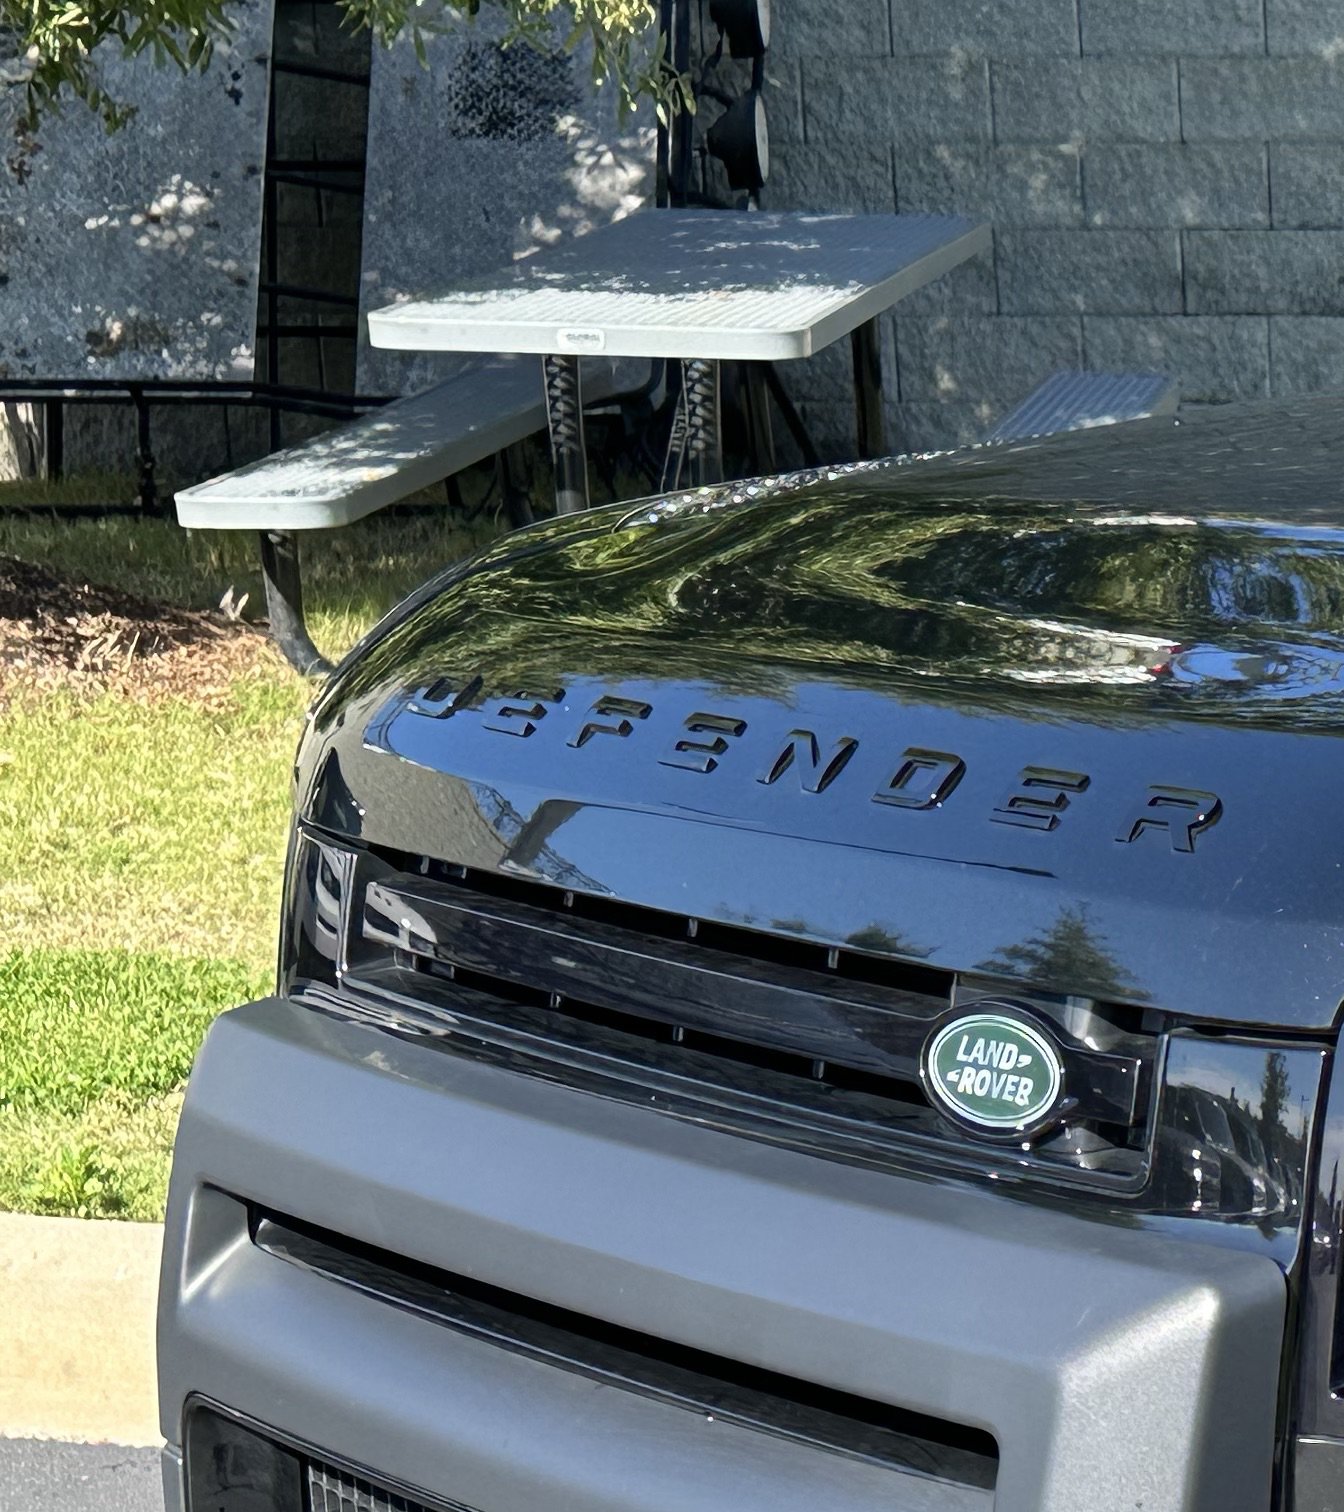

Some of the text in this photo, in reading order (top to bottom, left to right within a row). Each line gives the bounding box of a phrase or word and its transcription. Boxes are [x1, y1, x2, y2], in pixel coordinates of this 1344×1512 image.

[406, 674, 1224, 855] DEFENDER
[956, 1034, 1019, 1071] LAND
[957, 1066, 1034, 1107] ROVER
